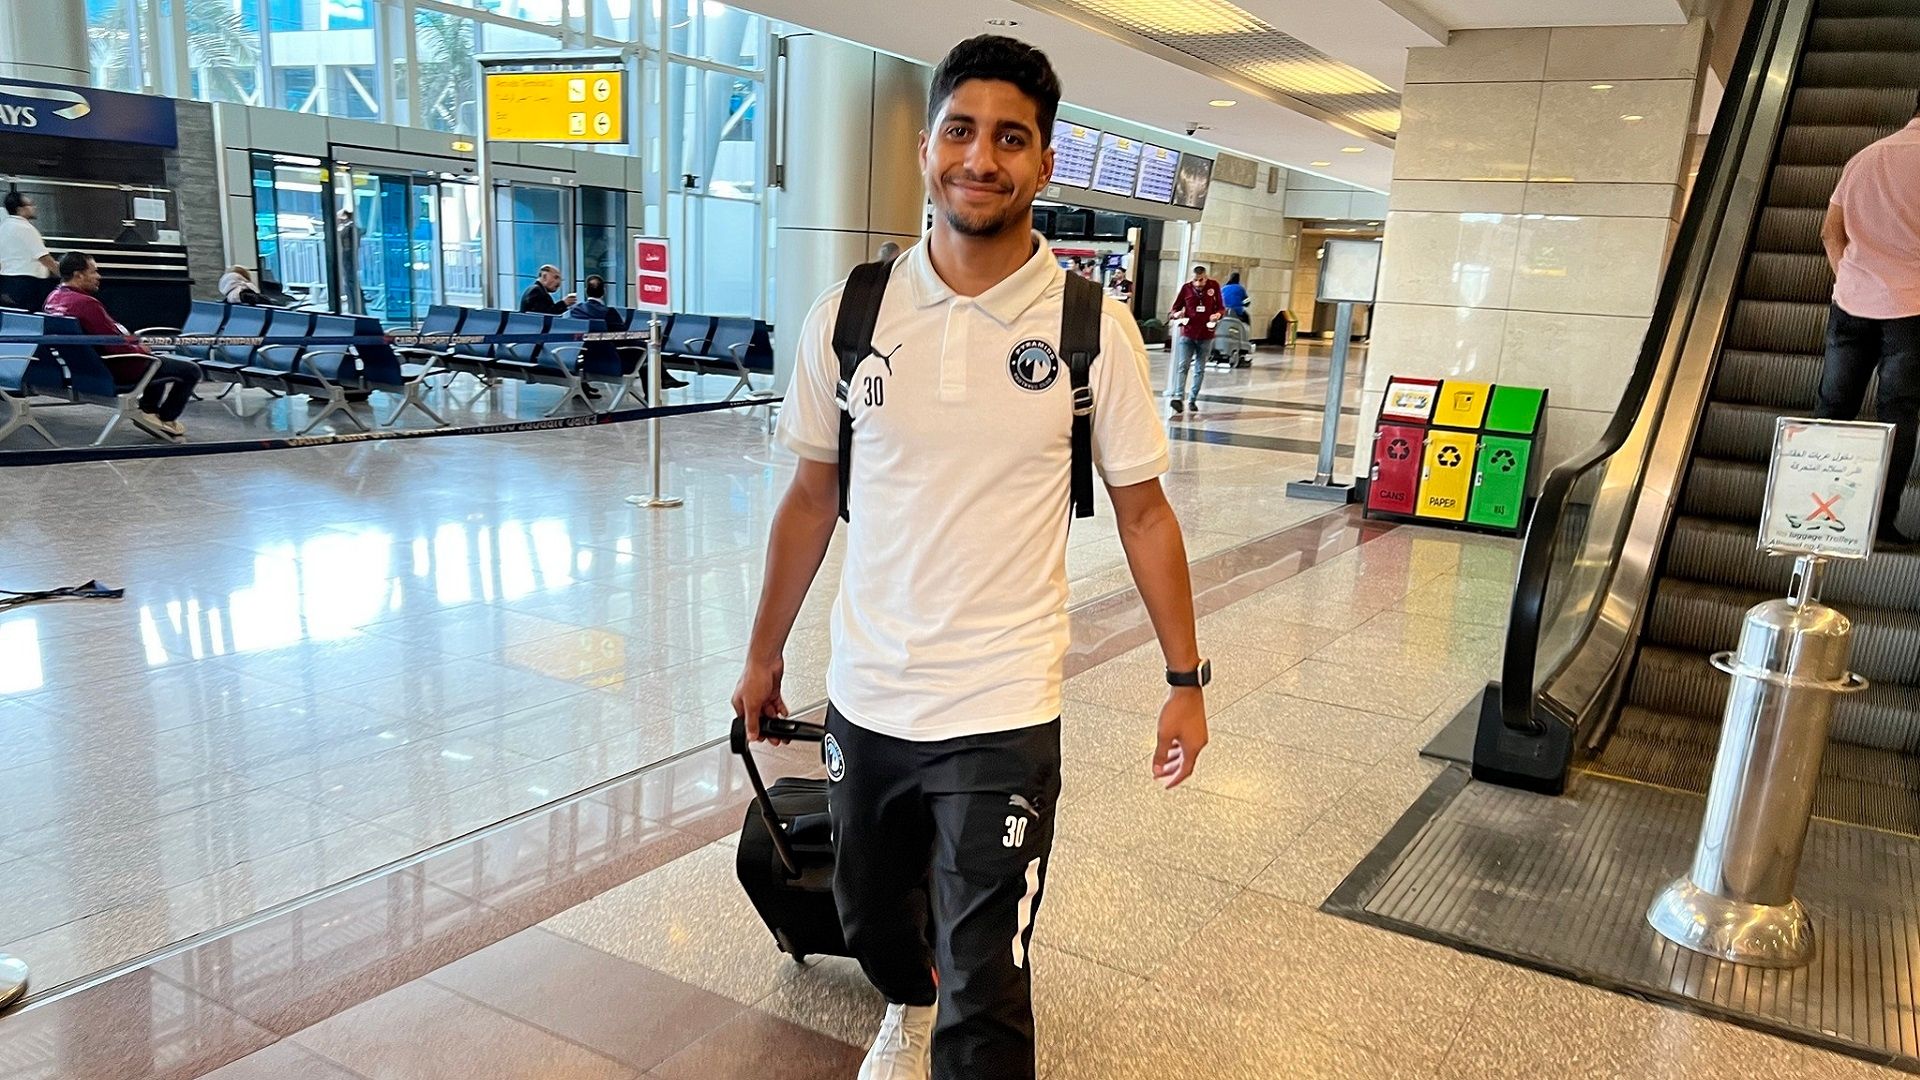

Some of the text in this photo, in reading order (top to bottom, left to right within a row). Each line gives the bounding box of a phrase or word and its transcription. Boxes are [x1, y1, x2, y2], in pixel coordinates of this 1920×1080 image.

[141, 336, 265, 346] CAIRO AIRPORT COMPANY
[1015, 341, 1056, 361] PYRAMIDS
[863, 375, 884, 407] 30
[1380, 490, 1404, 501] CANS
[1429, 497, 1456, 508] PAPER
[1002, 815, 1028, 848] 30
